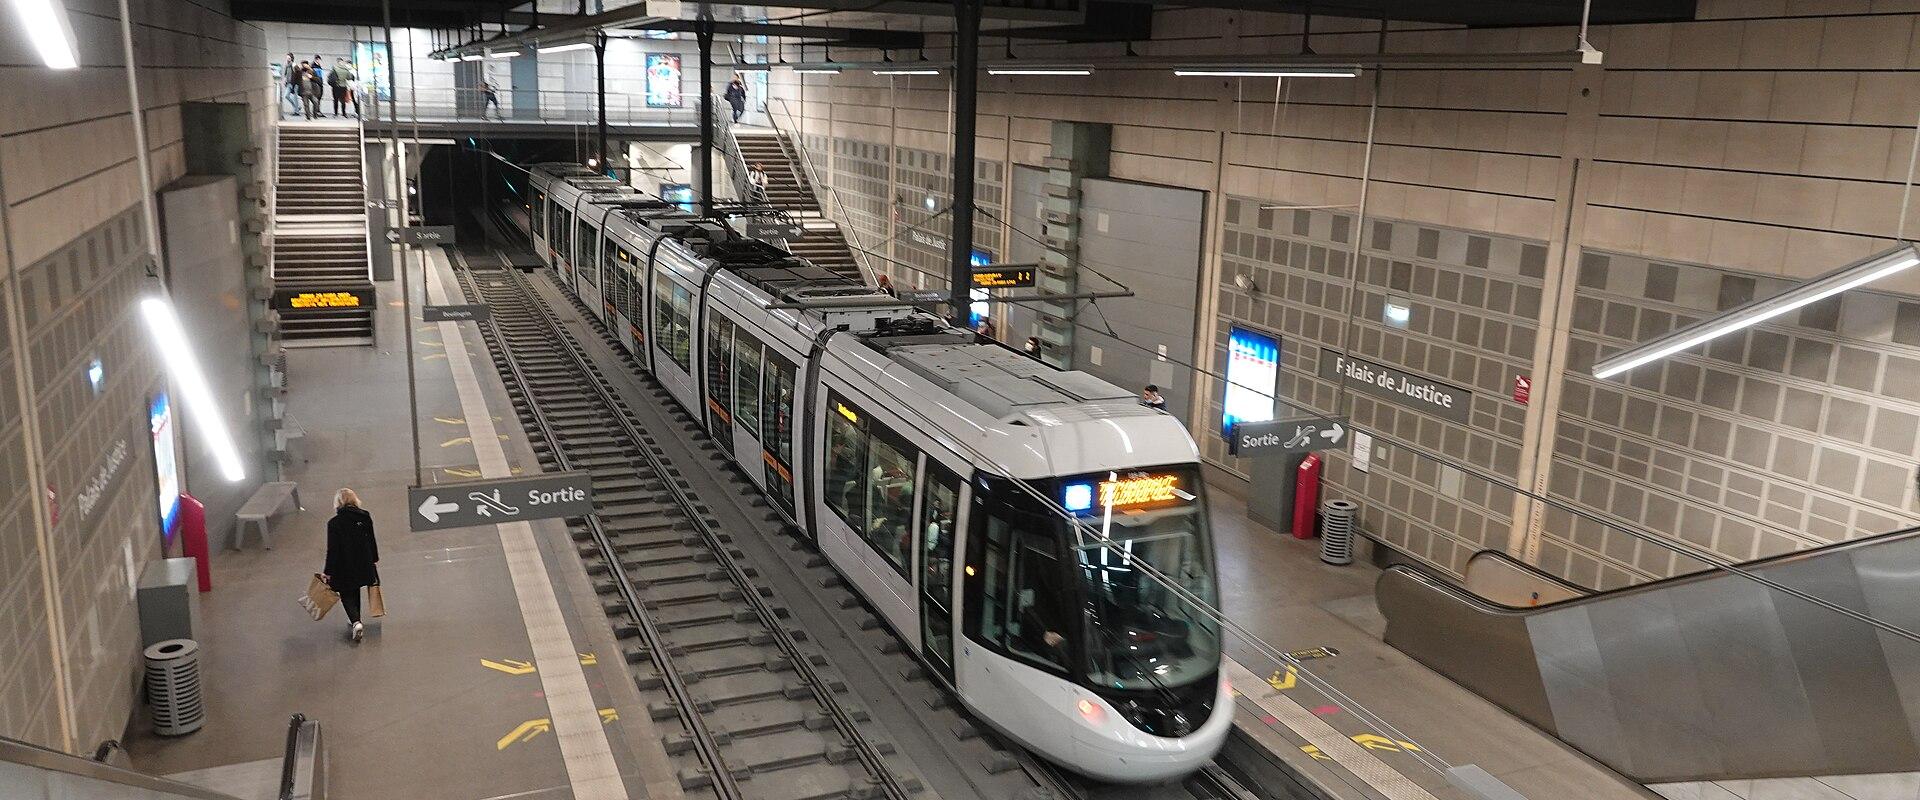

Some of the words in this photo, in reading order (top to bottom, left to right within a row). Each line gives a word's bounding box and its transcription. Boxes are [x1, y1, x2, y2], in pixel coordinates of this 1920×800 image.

[1336, 356, 1374, 384] Palais
[1377, 370, 1395, 391] de
[1396, 376, 1453, 409] Justice
[1242, 433, 1280, 448] Sortie
[528, 486, 586, 506] Sortie
